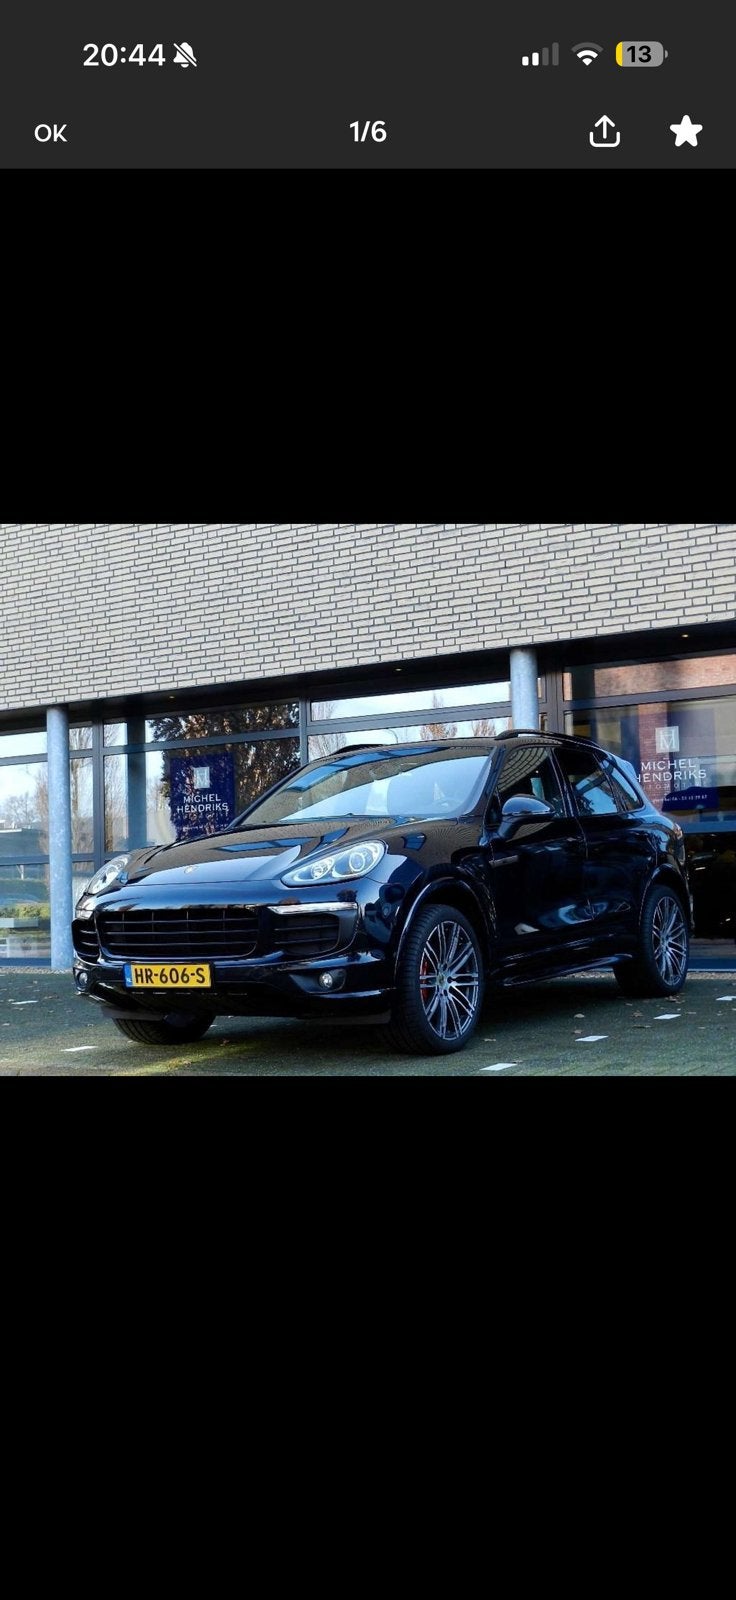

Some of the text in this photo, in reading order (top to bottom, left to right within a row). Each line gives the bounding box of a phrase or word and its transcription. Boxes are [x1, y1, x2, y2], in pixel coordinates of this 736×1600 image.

[641, 759, 697, 771] MICHEL
[183, 794, 221, 803] MICHEL
[177, 803, 229, 813] HENDRIKS
[134, 967, 206, 984] HR-606-S
